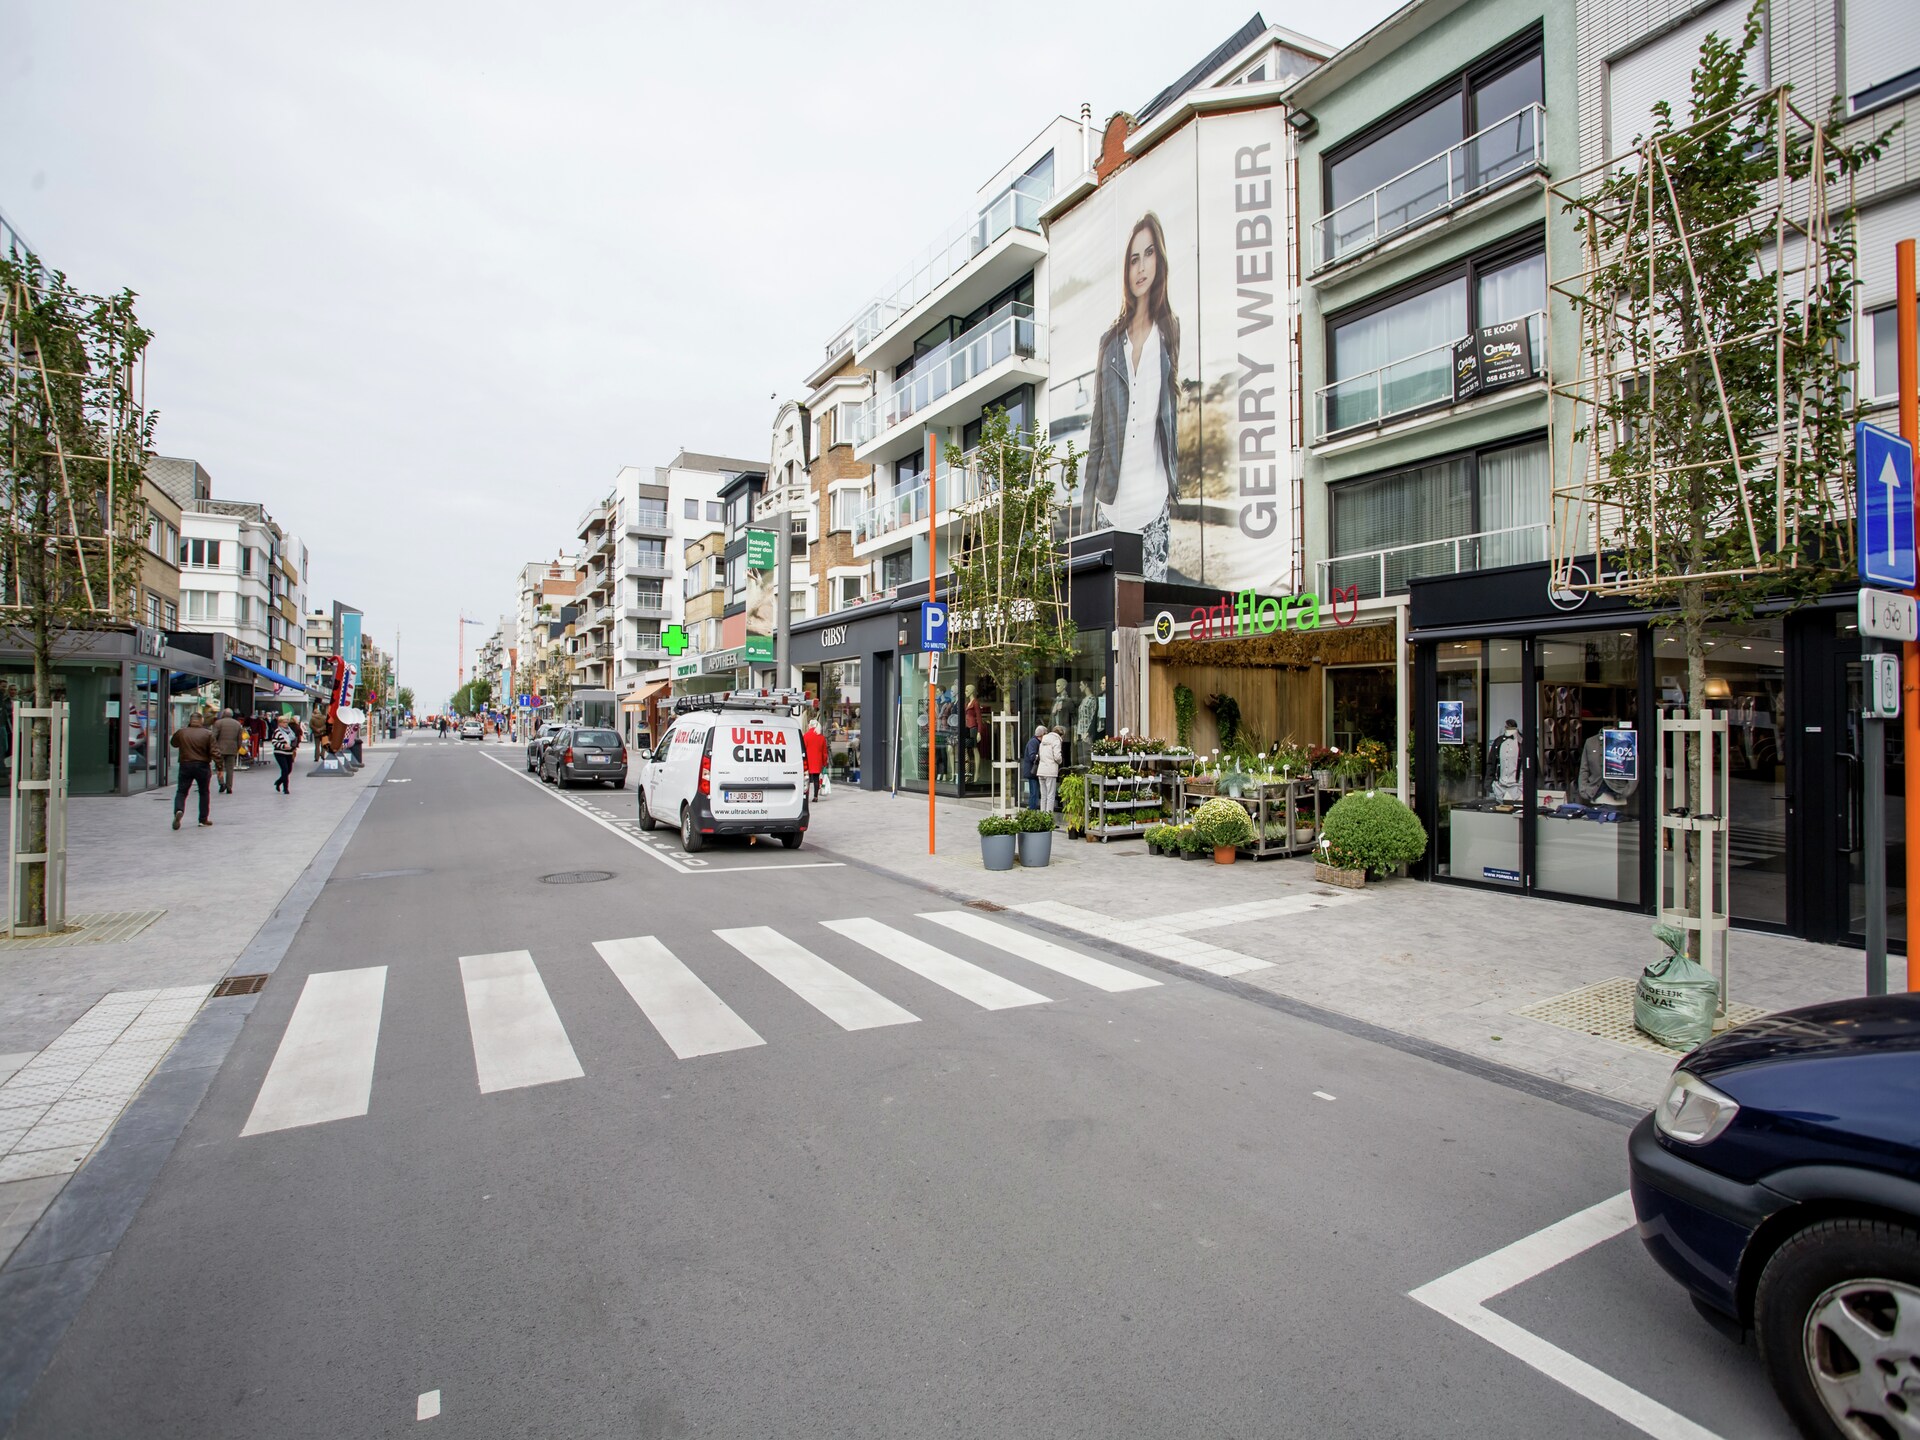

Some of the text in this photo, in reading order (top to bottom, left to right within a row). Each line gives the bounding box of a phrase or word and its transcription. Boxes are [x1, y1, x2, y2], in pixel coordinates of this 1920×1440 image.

[1483, 323, 1518, 337] TE KOOP
[1234, 142, 1278, 540] GERRY WEBER
[1483, 342, 1521, 356] Century 21
[926, 607, 945, 641] P
[1189, 588, 1320, 641] artiflora
[821, 625, 847, 647] GIBSY
[708, 653, 738, 670] APOTHEEK
[1606, 747, 1633, 756] -40%
